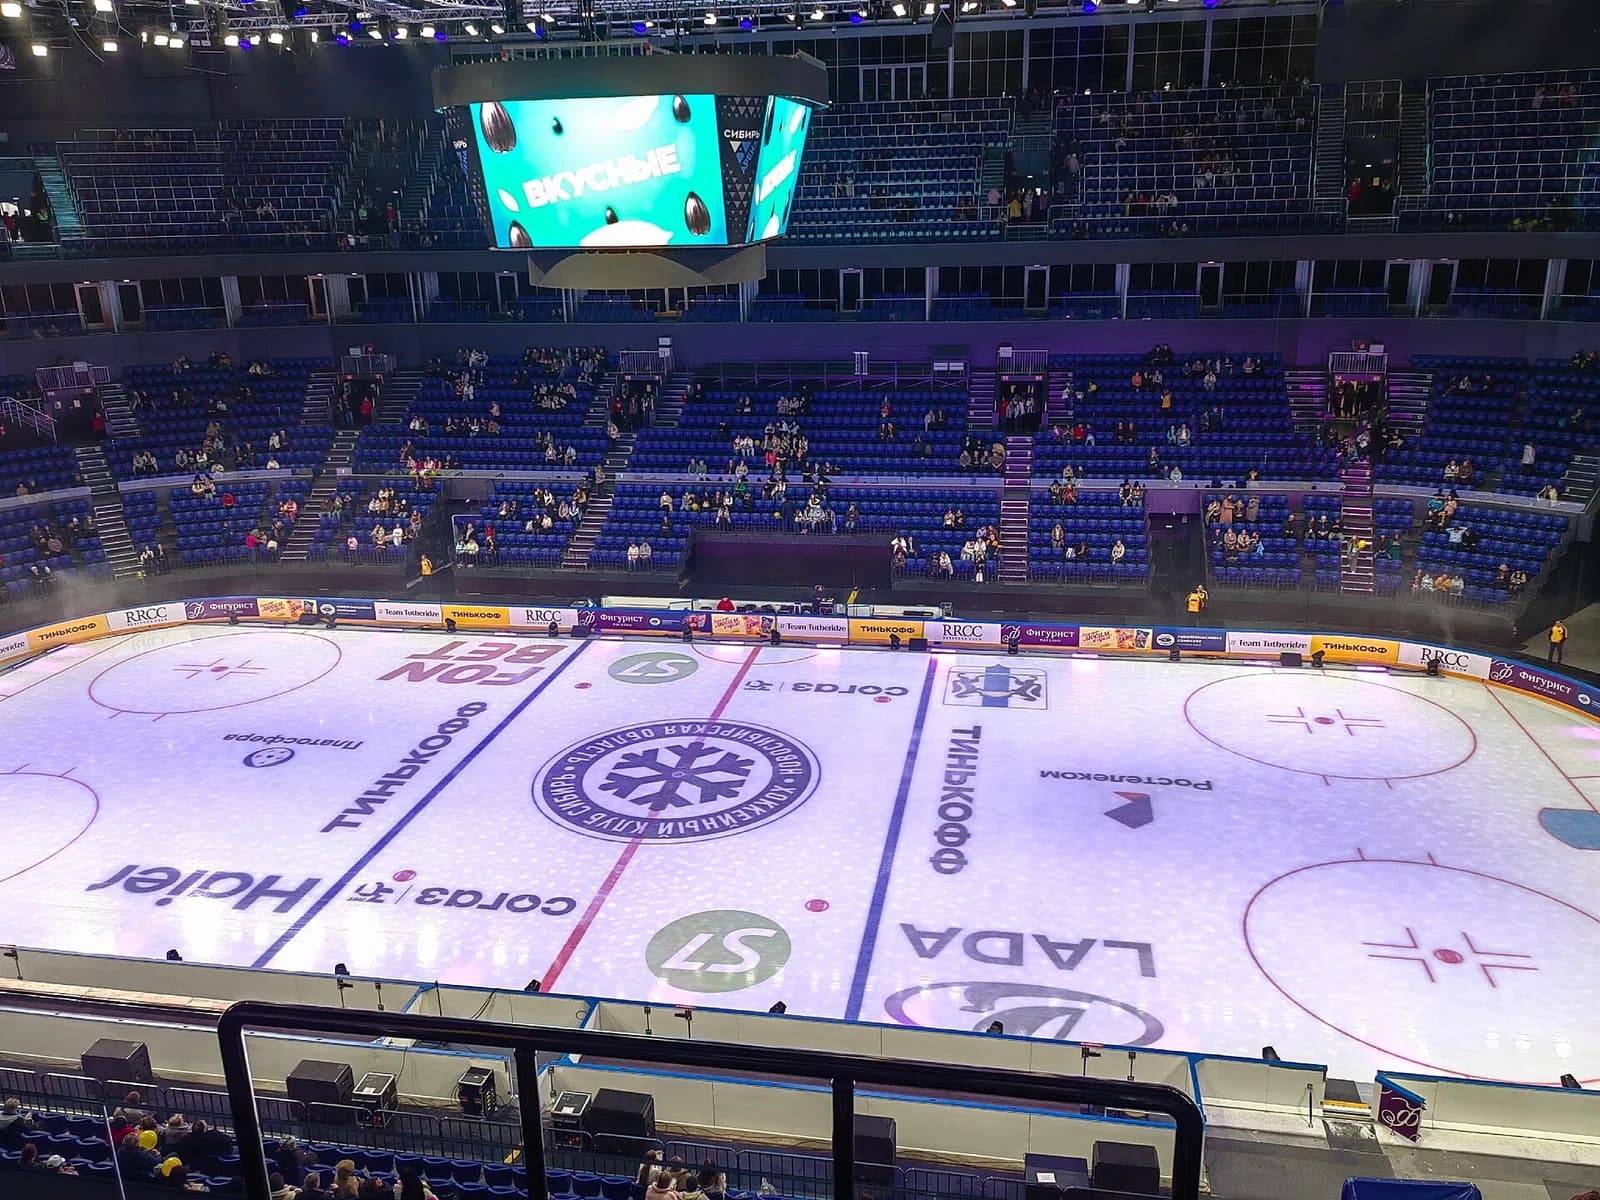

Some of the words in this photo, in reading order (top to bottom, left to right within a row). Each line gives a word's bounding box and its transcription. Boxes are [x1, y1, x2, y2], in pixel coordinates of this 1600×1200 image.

[723, 129, 760, 139] СИБИРЬ
[522, 143, 682, 209] ВКУСНЫЕ
[126, 607, 168, 623] RRCC
[210, 603, 254, 611] Фигурист
[451, 611, 501, 619] ТИНЬКОФФ
[525, 610, 562, 621] RRCC
[600, 613, 643, 622] Фигурист
[38, 622, 97, 641] ТИНЬКОФФ
[860, 625, 915, 634] ТИНЬКОФФ
[943, 624, 983, 637] RRCC
[1026, 629, 1075, 638] Фигурист
[405, 641, 568, 664] BET
[1263, 640, 1307, 648] Tutberidze
[1323, 642, 1387, 654] ТИНЬКОФФ
[1421, 648, 1469, 667] RRCC
[375, 661, 545, 686] FON
[616, 659, 692, 678] S7
[1519, 671, 1571, 694] Фигурист
[223, 733, 364, 750] Платосфера
[571, 728, 655, 764] ОБЛАСТЬ
[663, 724, 804, 776] НОВОСИБИРСКАЯ
[320, 702, 487, 833] ТИНЬКОФФ
[1039, 770, 1213, 791] Ростелеком
[549, 773, 585, 817] СИБИРЬ
[929, 725, 981, 875] ТИНЬКОФФ
[658, 786, 798, 838] ХОККЕЙНЫЙ
[583, 812, 648, 835] КЛУБ
[85, 864, 322, 914] Haier
[661, 927, 777, 973] S7
[900, 923, 1157, 978] LADA
